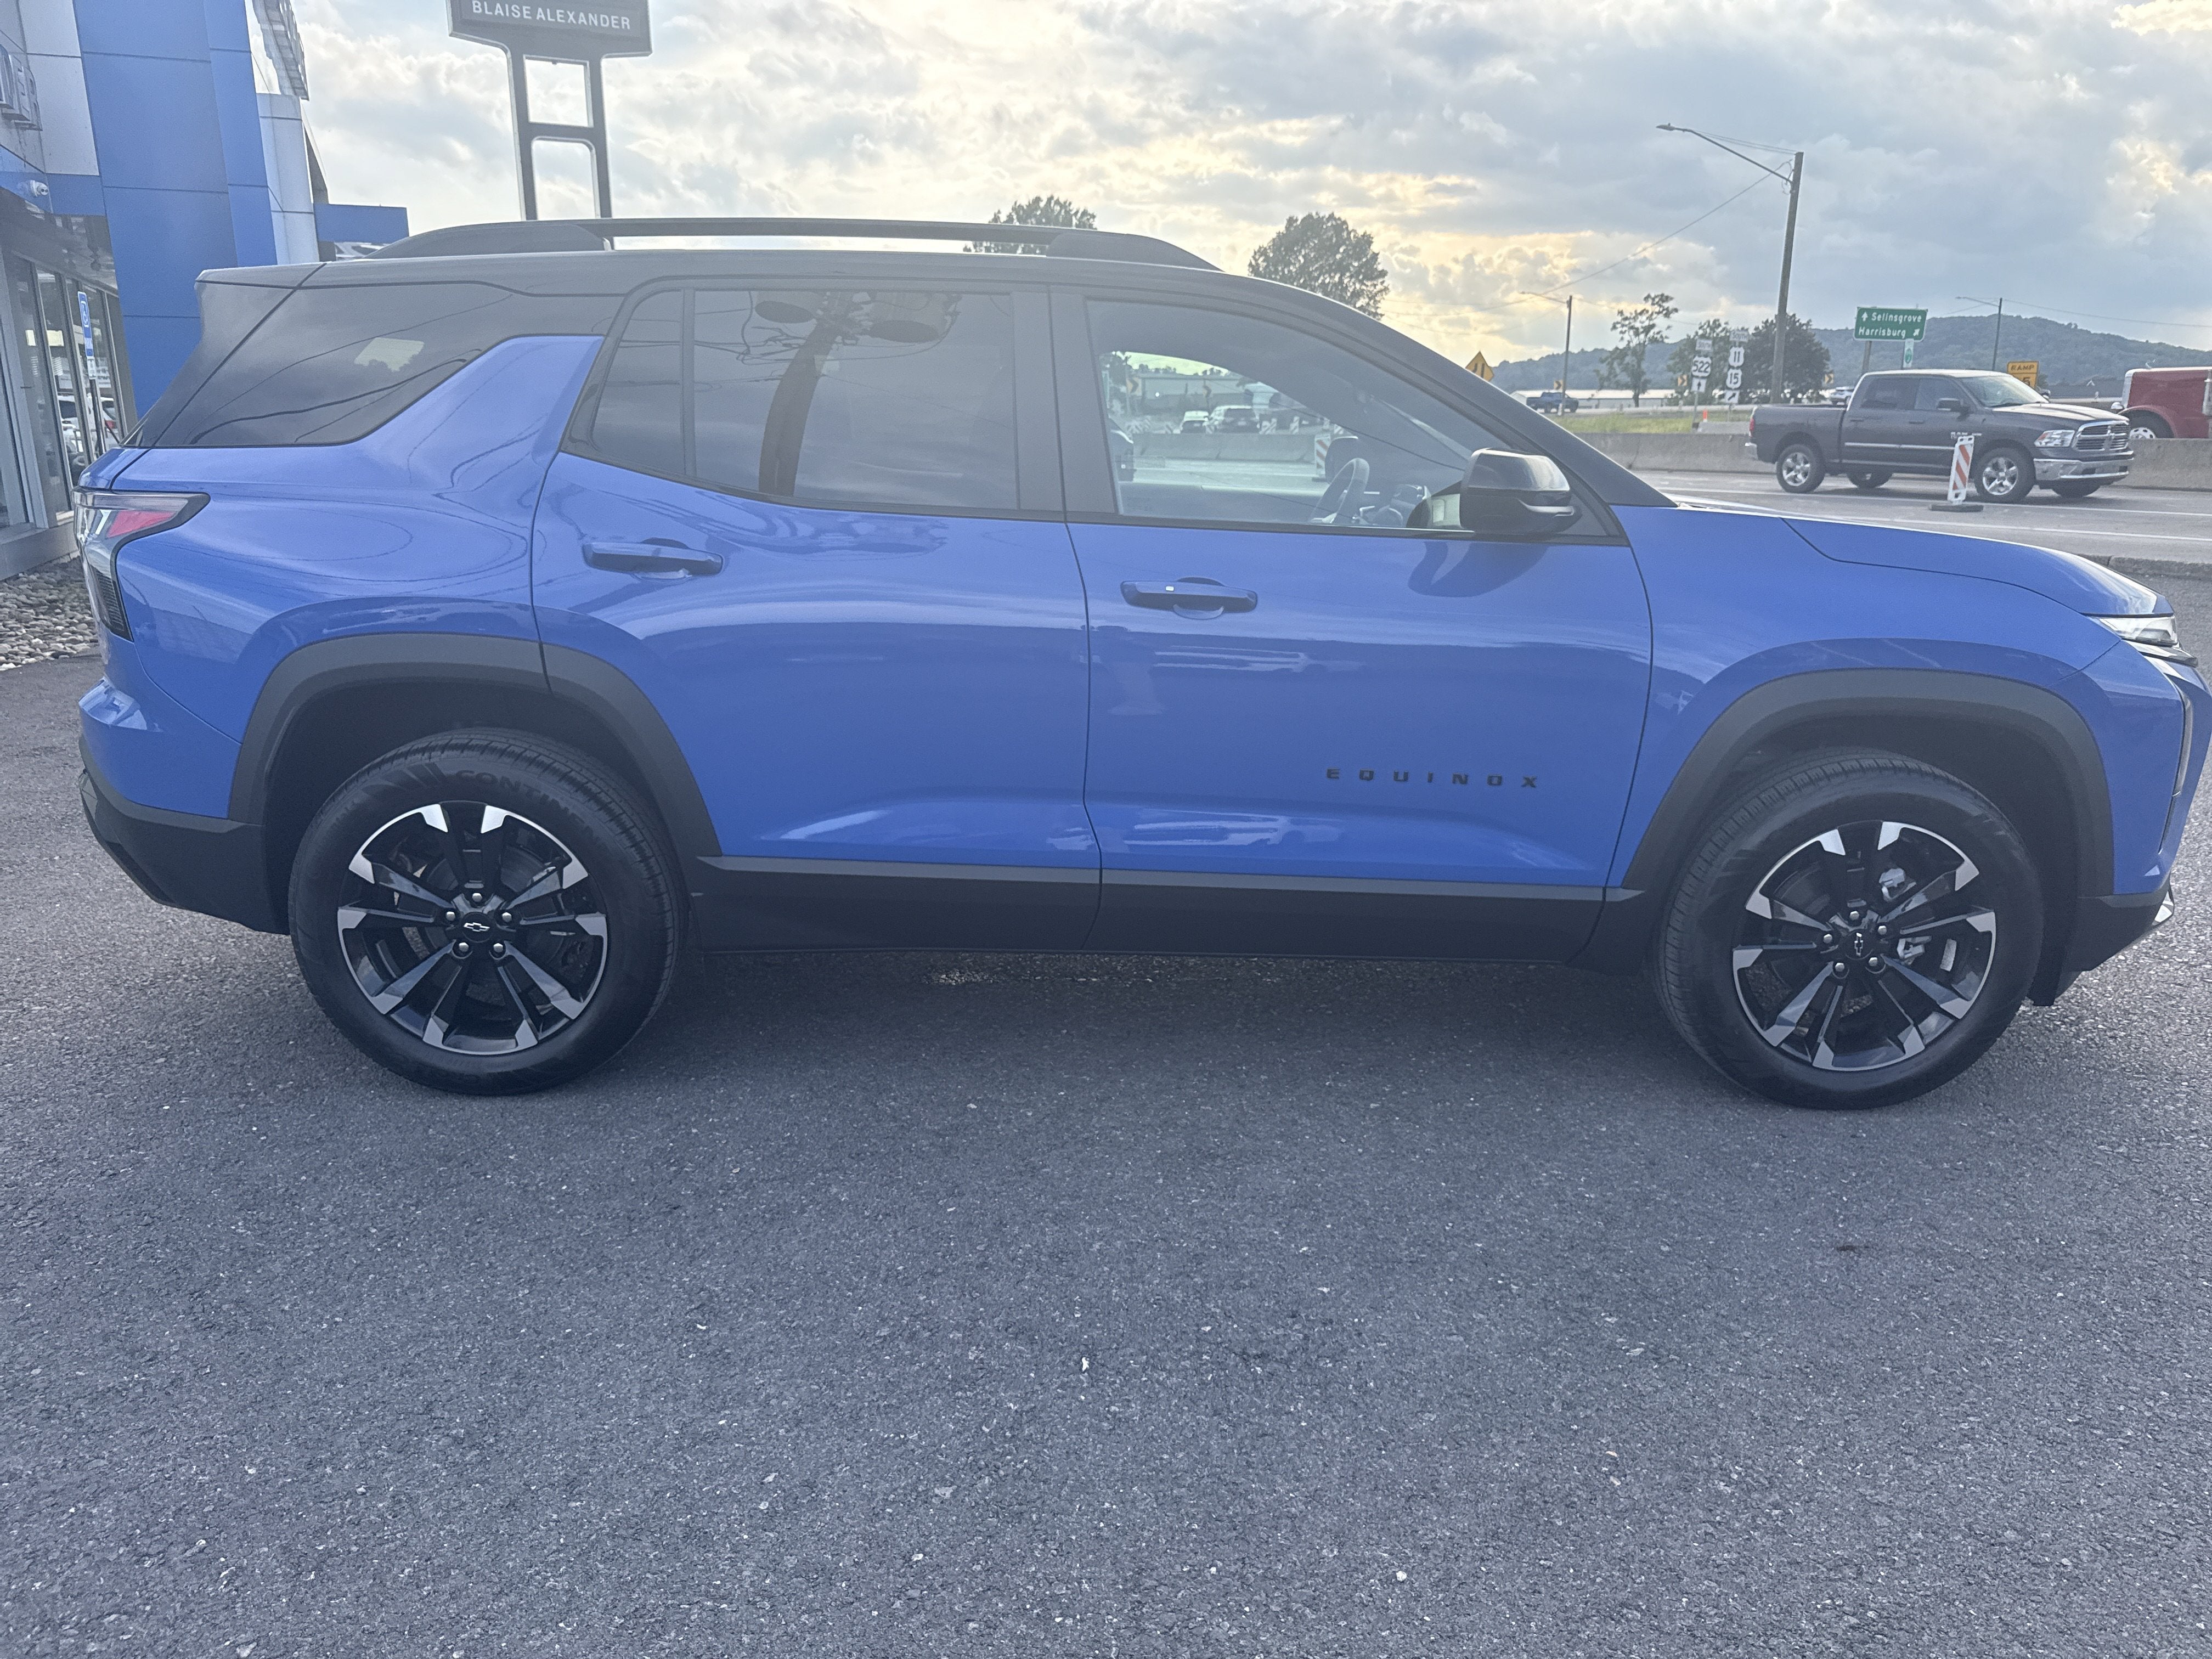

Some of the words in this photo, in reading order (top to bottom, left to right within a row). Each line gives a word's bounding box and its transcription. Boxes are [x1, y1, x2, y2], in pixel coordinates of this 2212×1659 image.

[472, 1, 532, 19] BLAISE
[536, 7, 630, 30] ALEXANDER
[1871, 312, 1922, 325] Selinsgrove
[1858, 326, 1906, 339] Harrisburg
[1734, 351, 1740, 363] 11
[1693, 360, 1710, 373] 522
[1730, 373, 1739, 385] 15
[1327, 768, 1537, 788] EQUINOX
